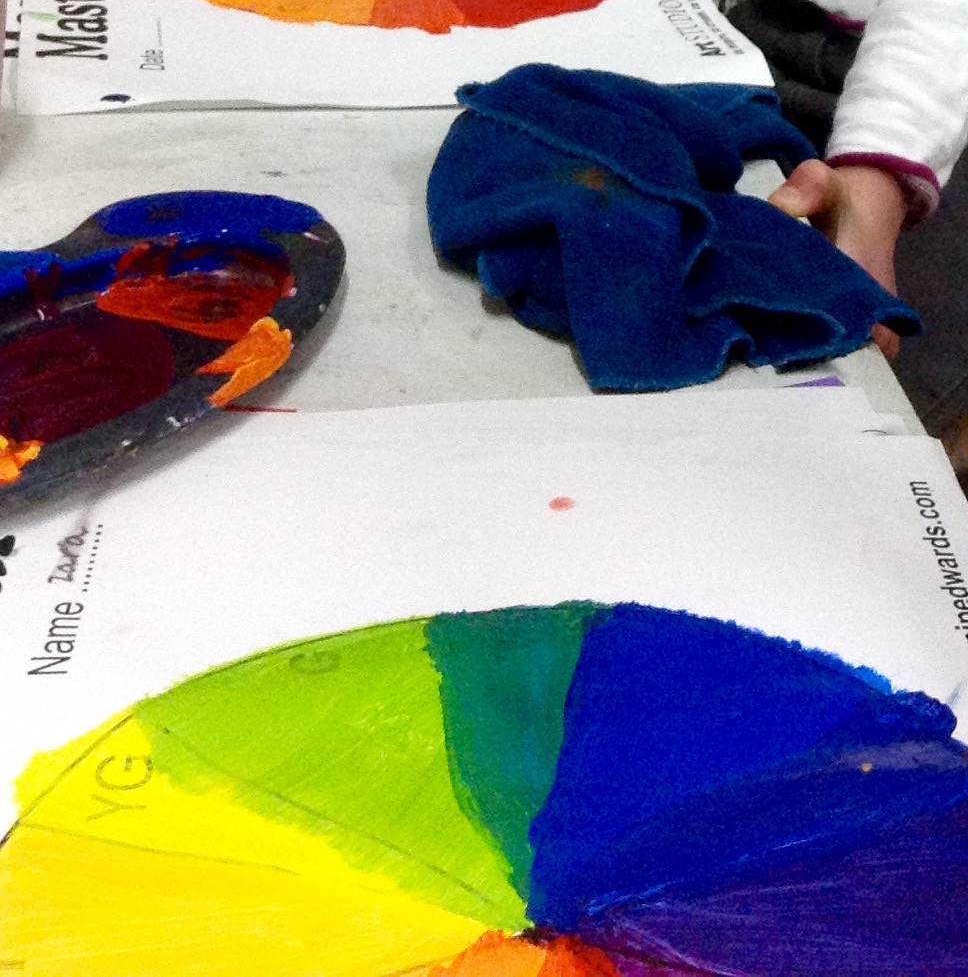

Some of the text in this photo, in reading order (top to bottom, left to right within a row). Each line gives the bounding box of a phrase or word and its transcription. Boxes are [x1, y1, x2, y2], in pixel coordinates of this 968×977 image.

[140, 49, 165, 71] Date
[27, 601, 85, 676] Name
[87, 755, 155, 821] YG
